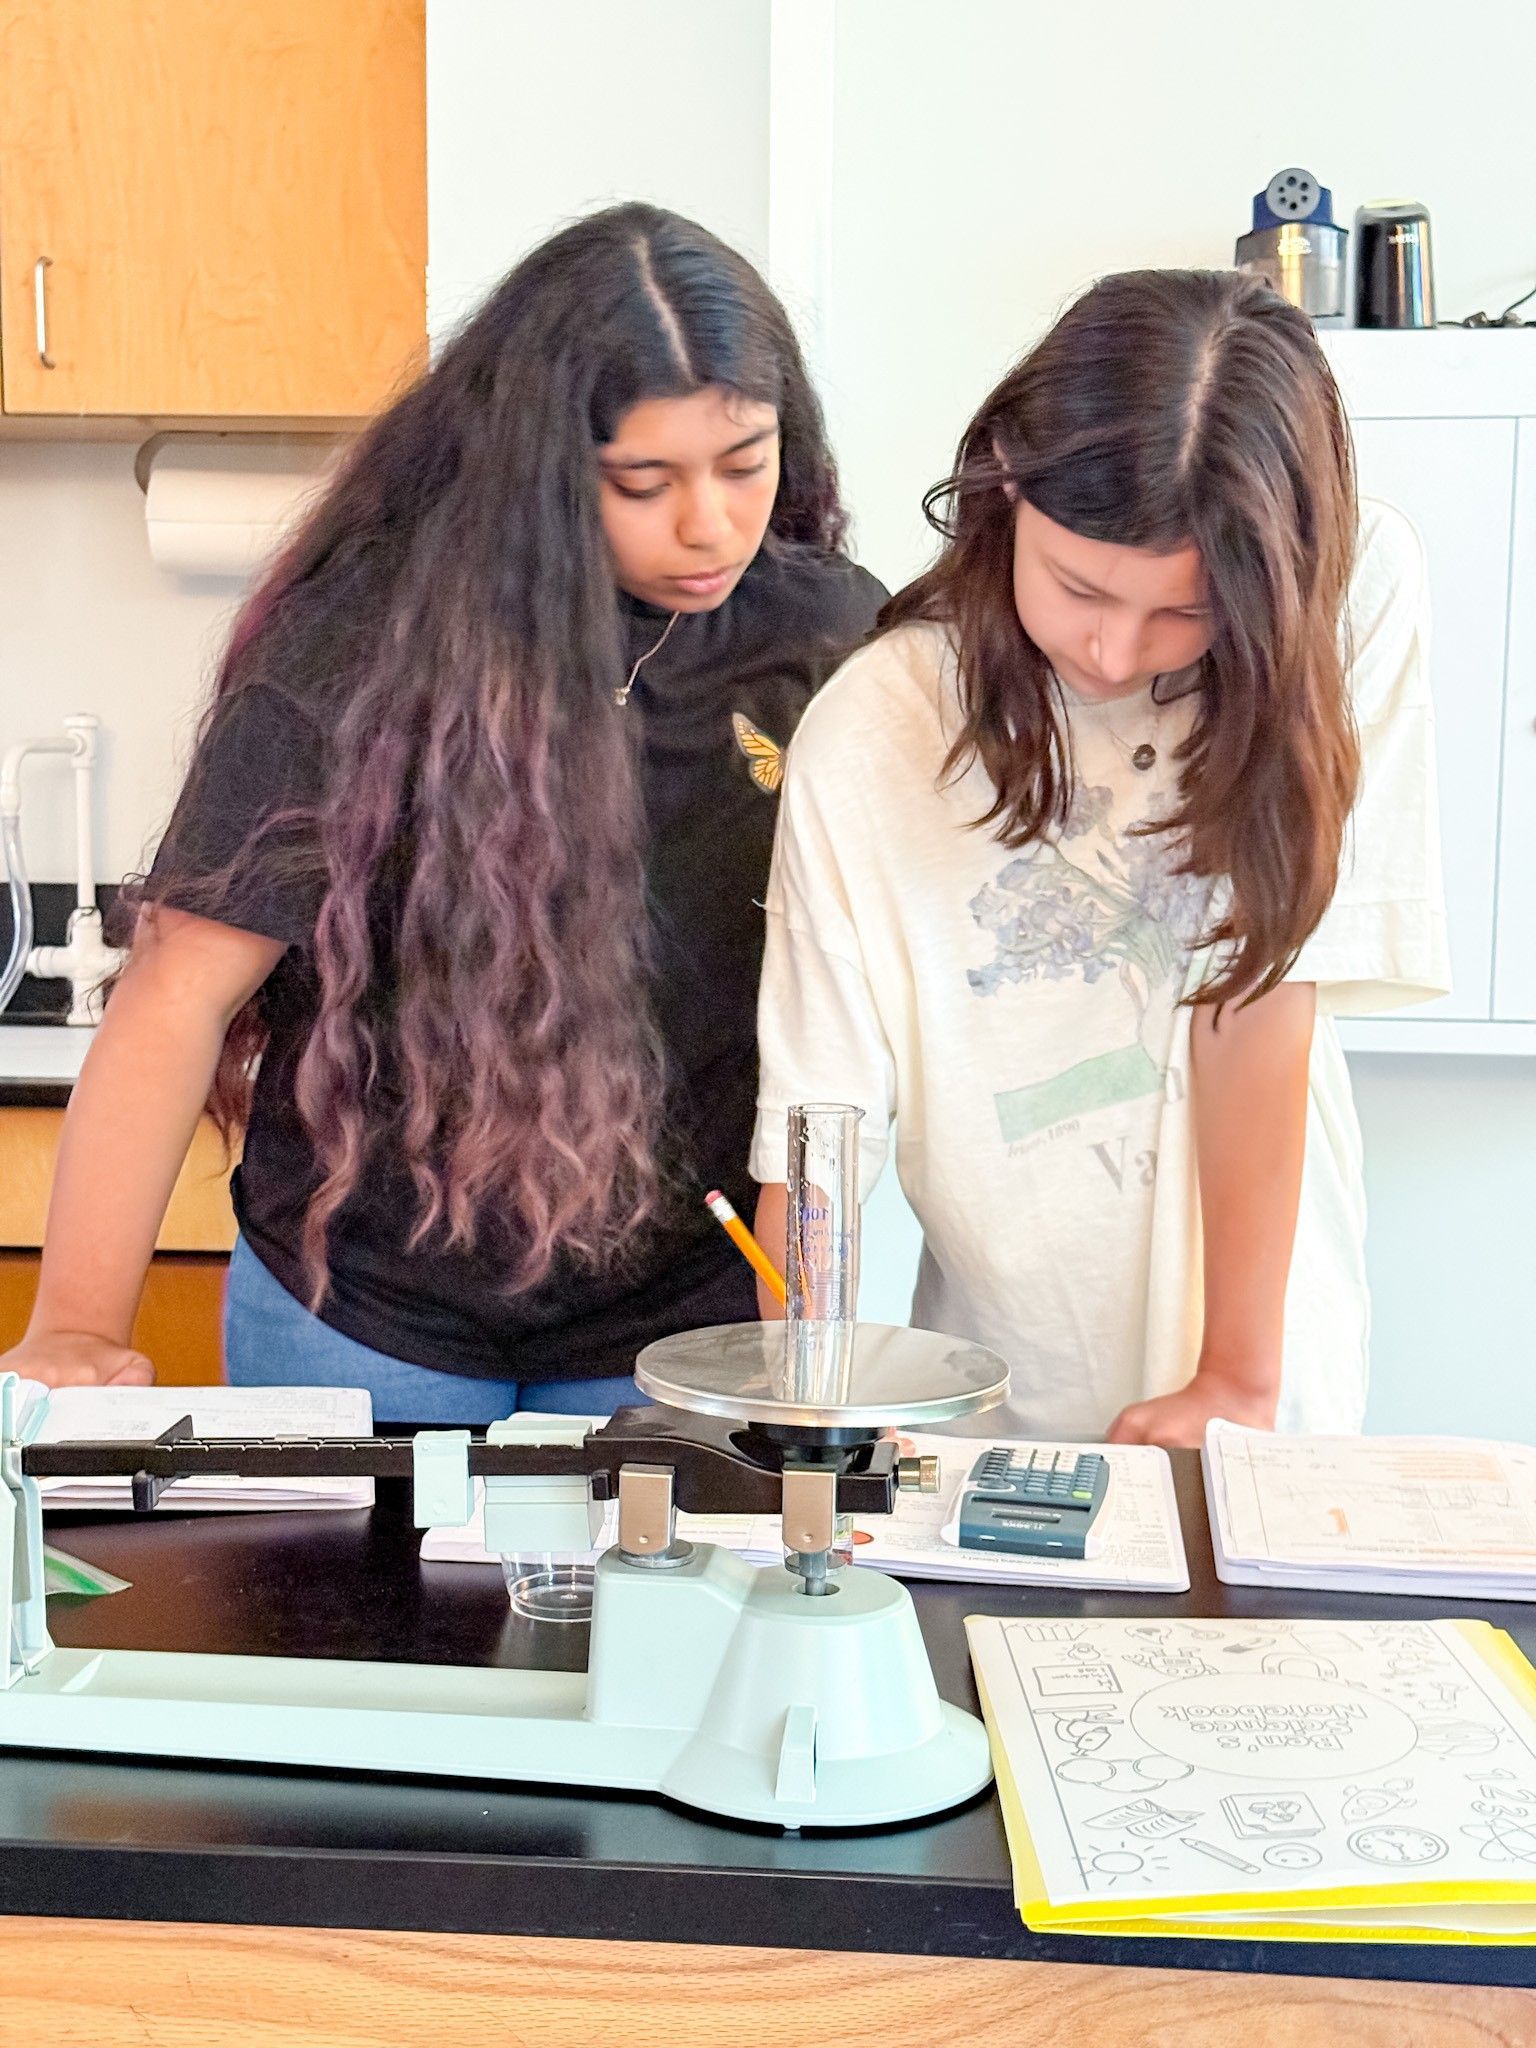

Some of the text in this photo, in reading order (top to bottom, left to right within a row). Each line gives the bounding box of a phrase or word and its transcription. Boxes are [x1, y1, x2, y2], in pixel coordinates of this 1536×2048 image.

[1157, 1703, 1368, 1722] Notebook
[1189, 1718, 1352, 1736] Science
[1216, 1733, 1344, 1752] Ben's
